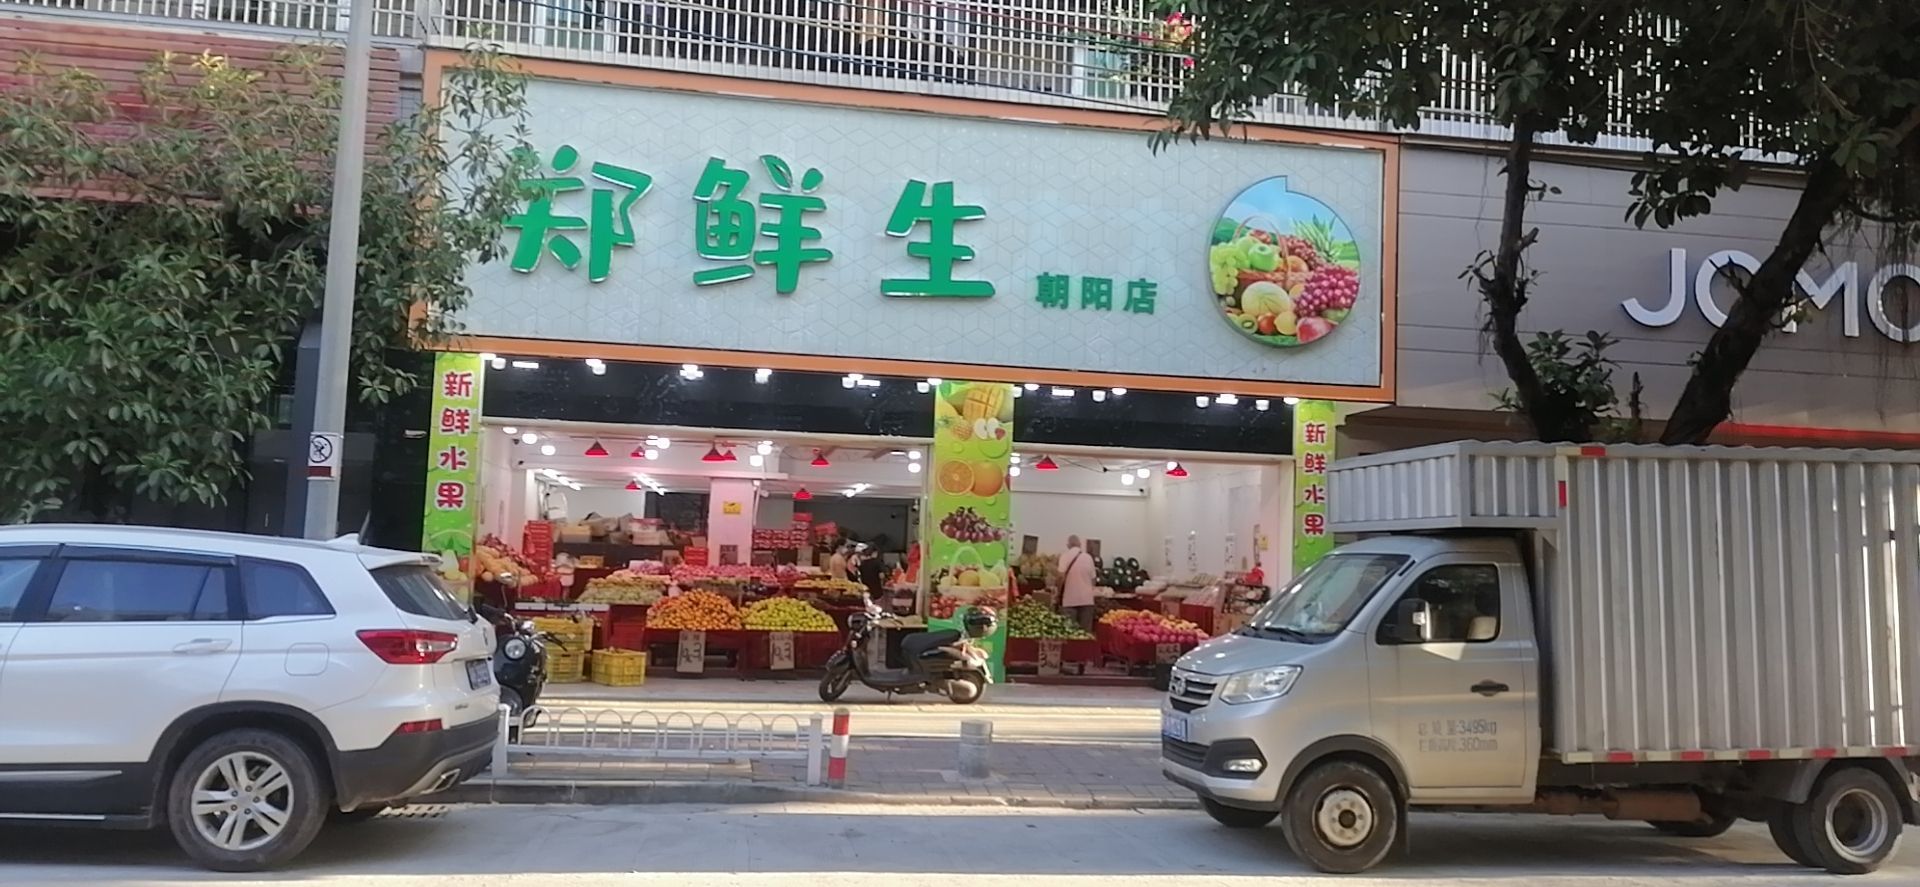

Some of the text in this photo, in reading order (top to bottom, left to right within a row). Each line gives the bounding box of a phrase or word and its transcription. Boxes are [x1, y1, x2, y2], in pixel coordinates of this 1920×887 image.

[501, 144, 997, 298] 郑鲜生
[1035, 271, 1158, 315] 朝阳店
[436, 370, 473, 509] 新鲜水果
[1303, 422, 1327, 536] 新鲜水果
